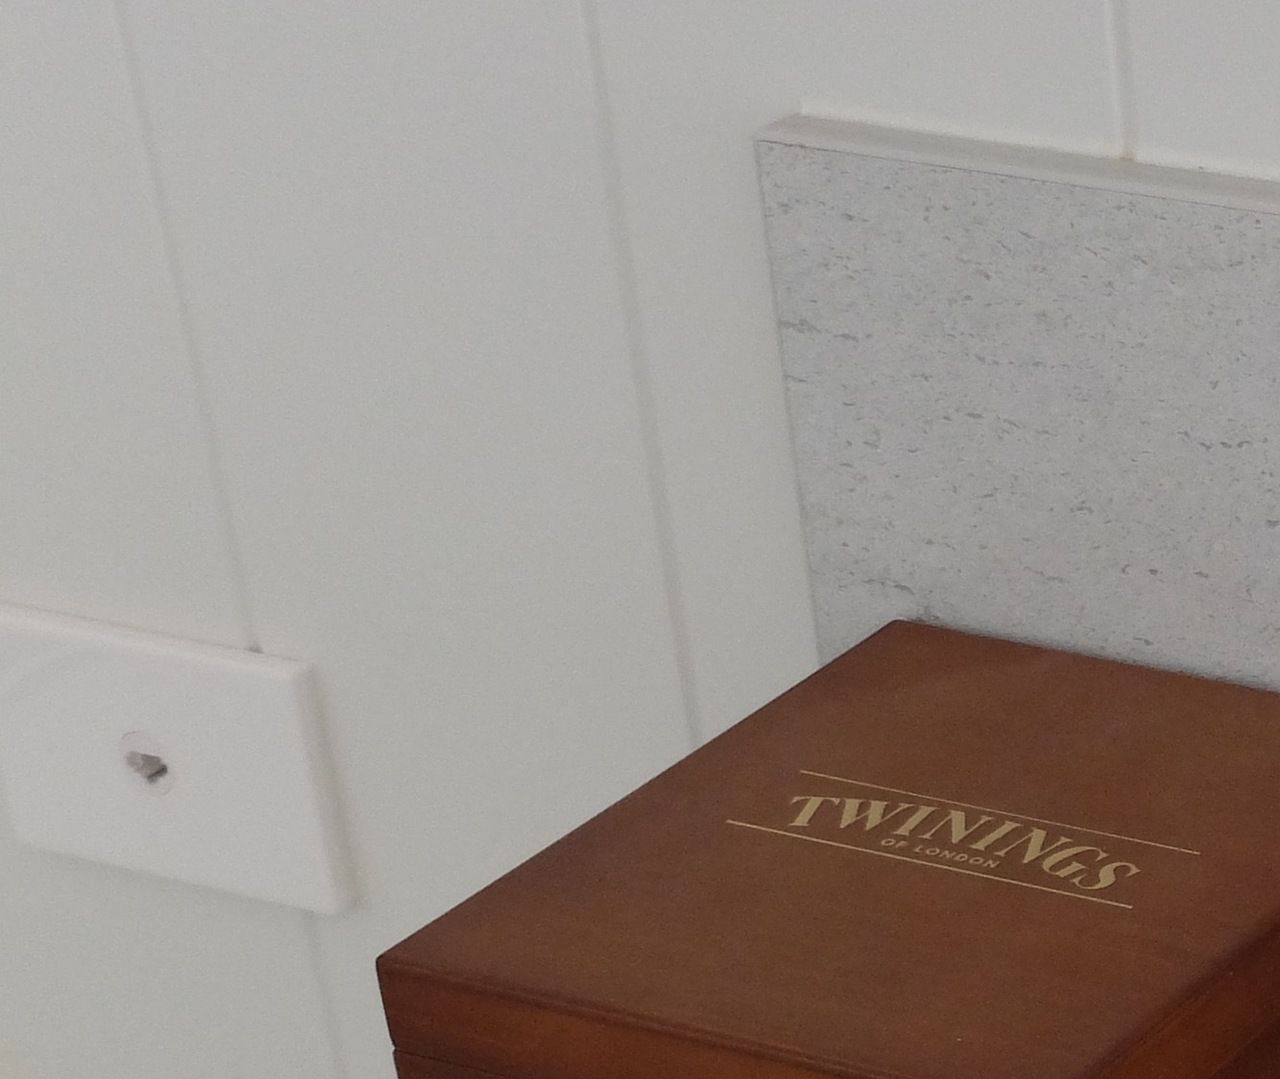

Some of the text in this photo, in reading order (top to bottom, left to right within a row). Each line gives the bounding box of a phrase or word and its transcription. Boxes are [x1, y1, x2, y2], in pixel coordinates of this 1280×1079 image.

[788, 796, 1141, 890] TWININGS
[881, 837, 1000, 869] OF LONDON
